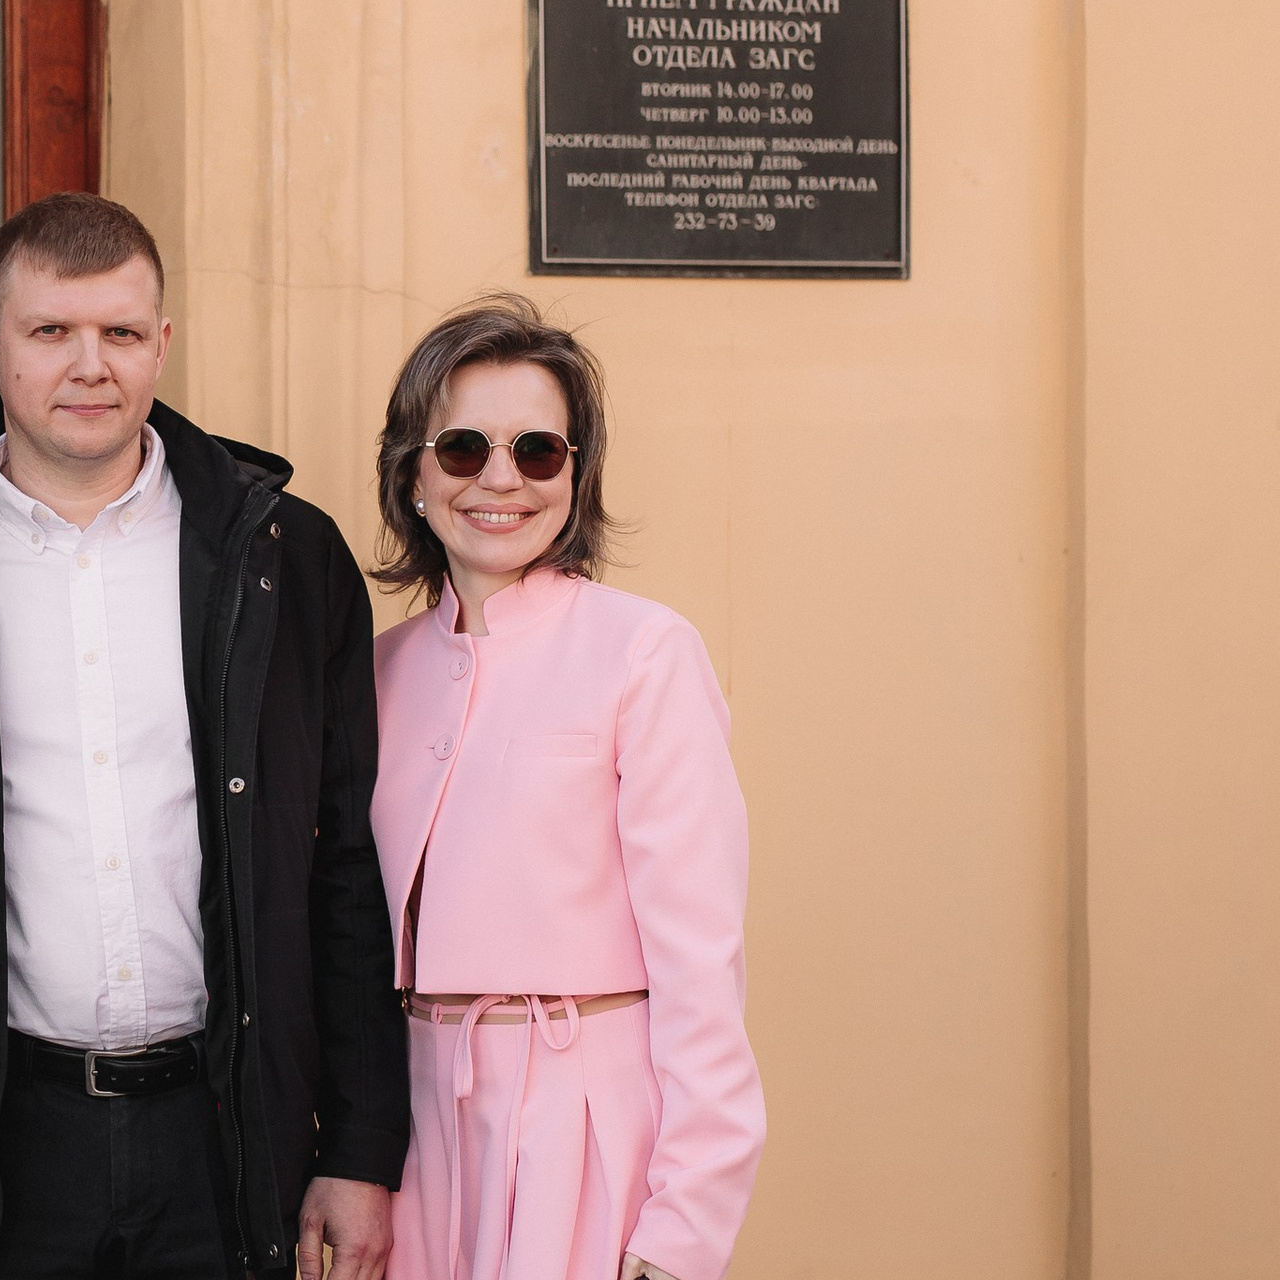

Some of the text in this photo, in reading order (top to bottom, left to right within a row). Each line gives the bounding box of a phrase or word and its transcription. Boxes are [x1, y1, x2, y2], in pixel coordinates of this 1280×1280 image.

[626, 16, 822, 44] НАЧАЛЬНИКОМ
[632, 44, 816, 72] ОТДЕЛА ЗАГС
[641, 82, 712, 99] ВТОРНИК
[640, 106, 710, 122] ЧЕТВЕРГ
[545, 133, 651, 149] ВОСКРЕСЕНЬЕ
[857, 140, 899, 156] ДЕНЬ
[646, 152, 754, 171] САНИТАРНЫЙ
[566, 171, 666, 189] ПОСЛЕДНИЙ
[749, 174, 792, 191] ДЕНЬ
[797, 176, 878, 192] КВАРТАЛА
[624, 192, 699, 208] ТЕЛЕФОН
[705, 192, 768, 209] ОТДЕЛА
